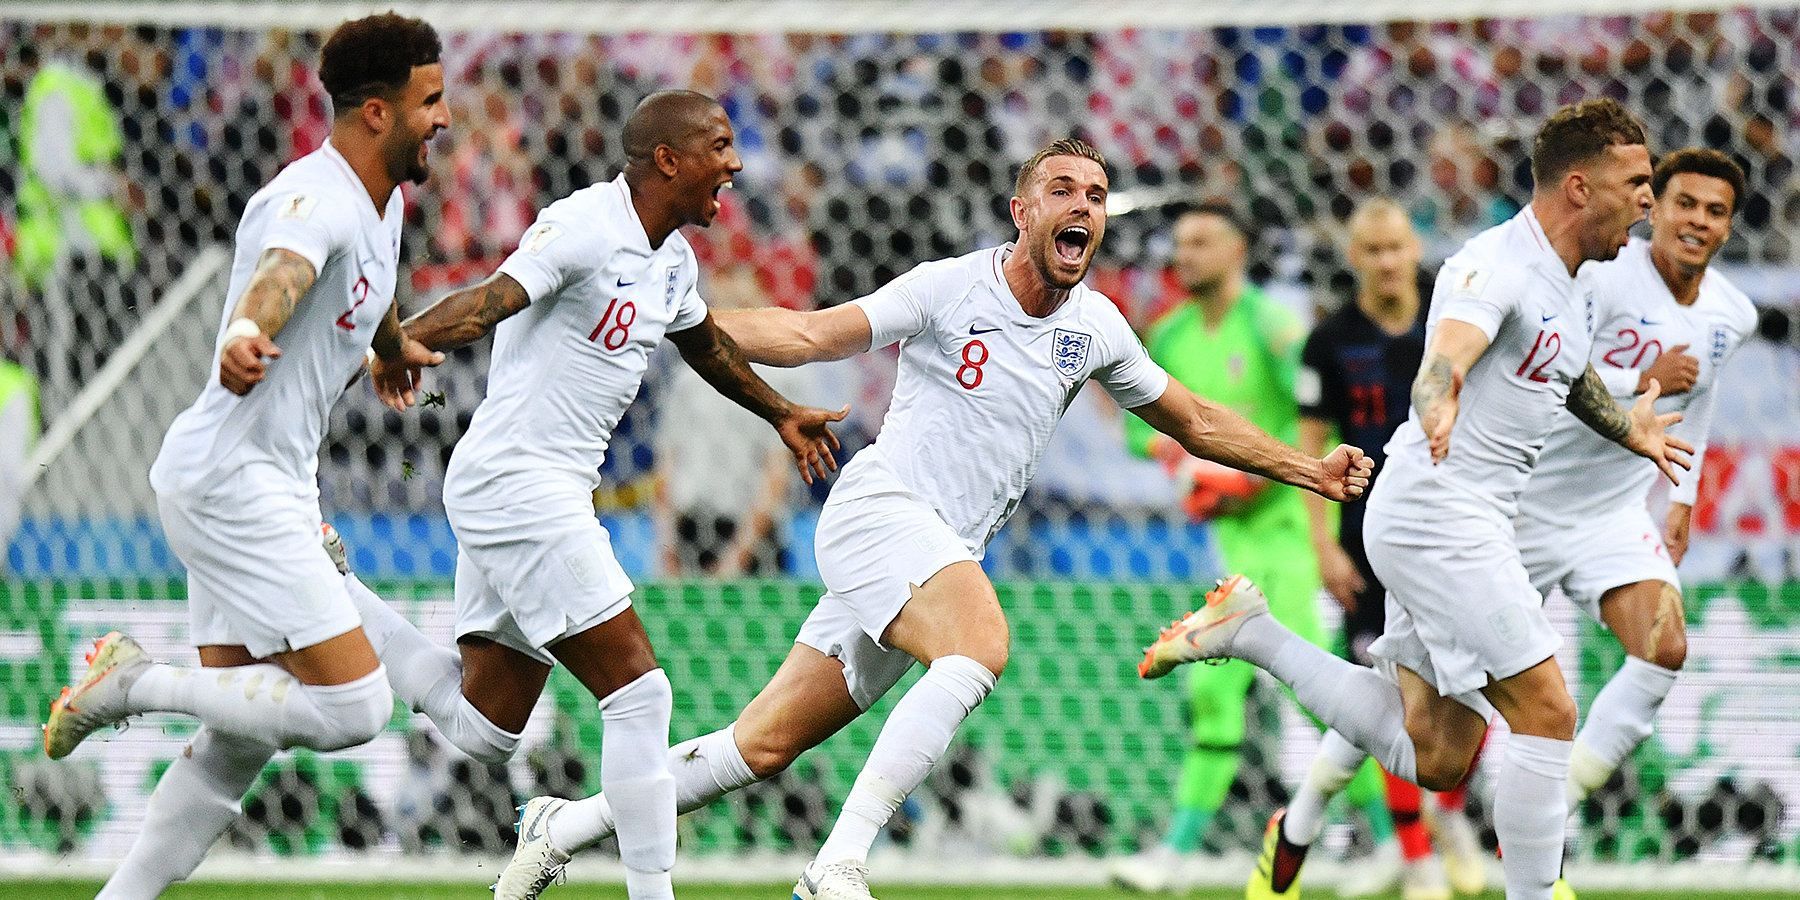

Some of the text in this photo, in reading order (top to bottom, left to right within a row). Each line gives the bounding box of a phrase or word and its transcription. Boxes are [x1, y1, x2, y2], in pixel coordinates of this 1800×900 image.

[335, 276, 369, 330] 2
[588, 298, 636, 351] 18
[956, 340, 989, 390] 8
[1516, 330, 1561, 384] 12
